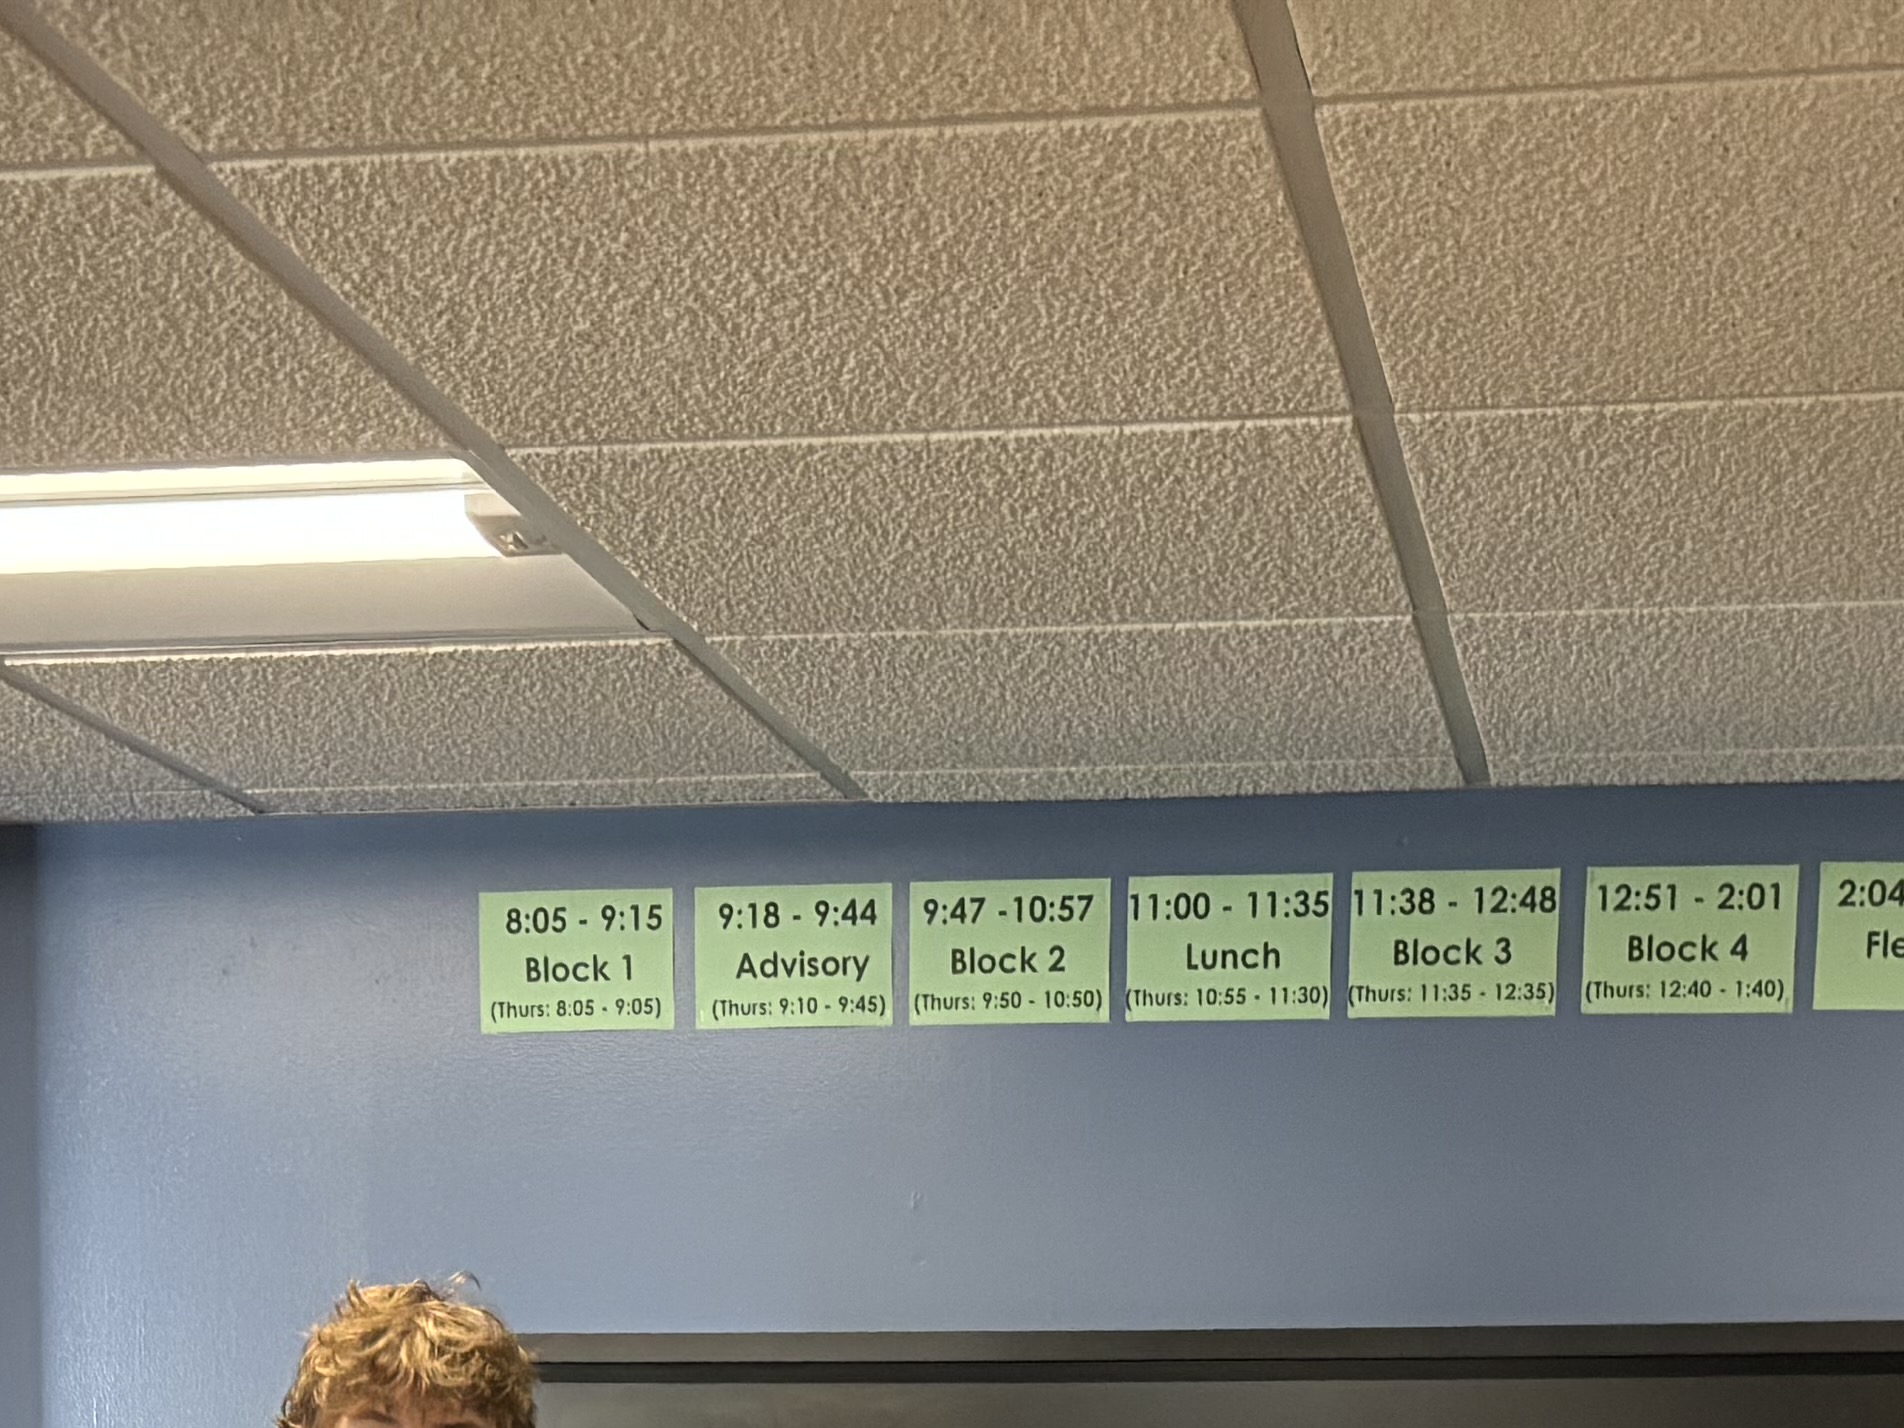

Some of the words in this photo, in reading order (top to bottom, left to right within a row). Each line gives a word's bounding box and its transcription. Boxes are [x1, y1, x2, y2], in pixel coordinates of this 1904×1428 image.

[923, 896, 986, 925] 9:47
[1130, 892, 1211, 921] 11:00
[1247, 889, 1329, 919] 11:35
[1353, 886, 1436, 917] 11:38
[1474, 885, 1557, 915] 12:48
[1598, 882, 1677, 912] 12:51
[1717, 881, 1780, 911] 2:01
[506, 906, 567, 934] 8:05
[601, 904, 662, 931] 9:15
[718, 901, 780, 930] 9:18
[814, 898, 877, 927] 9:44
[951, 945, 1038, 975] Block
[1048, 945, 1066, 972] 2
[1186, 941, 1281, 971] Lunch
[1393, 937, 1483, 966] Block
[1494, 936, 1512, 965] 3
[1627, 933, 1719, 963] Block
[1729, 933, 1749, 962] 4
[525, 954, 611, 983] Block
[622, 954, 632, 981] 1
[736, 950, 870, 982] Advisory
[914, 992, 976, 1016] (Thurs:
[982, 991, 1022, 1010] 9:50
[1044, 988, 1103, 1013] 10:50)
[1125, 988, 1188, 1014] (Thurs:
[1196, 986, 1246, 1006] 10:55
[1269, 985, 1329, 1009] 11:30)
[1348, 983, 1411, 1009] (Thurs:
[1420, 982, 1471, 1003] 11:35
[1495, 981, 1556, 1005] 12:35)
[1585, 979, 1650, 1005] (Thurs:
[1659, 979, 1712, 999] 12:40
[1735, 978, 1784, 1002] 1:40)
[490, 1000, 551, 1022] (Thurs:
[556, 999, 594, 1017] 8:05
[615, 997, 661, 1019] 9:05)
[712, 998, 773, 1021] (Thurs:
[779, 996, 818, 1015] 9:10
[838, 994, 886, 1017] 9:45)
